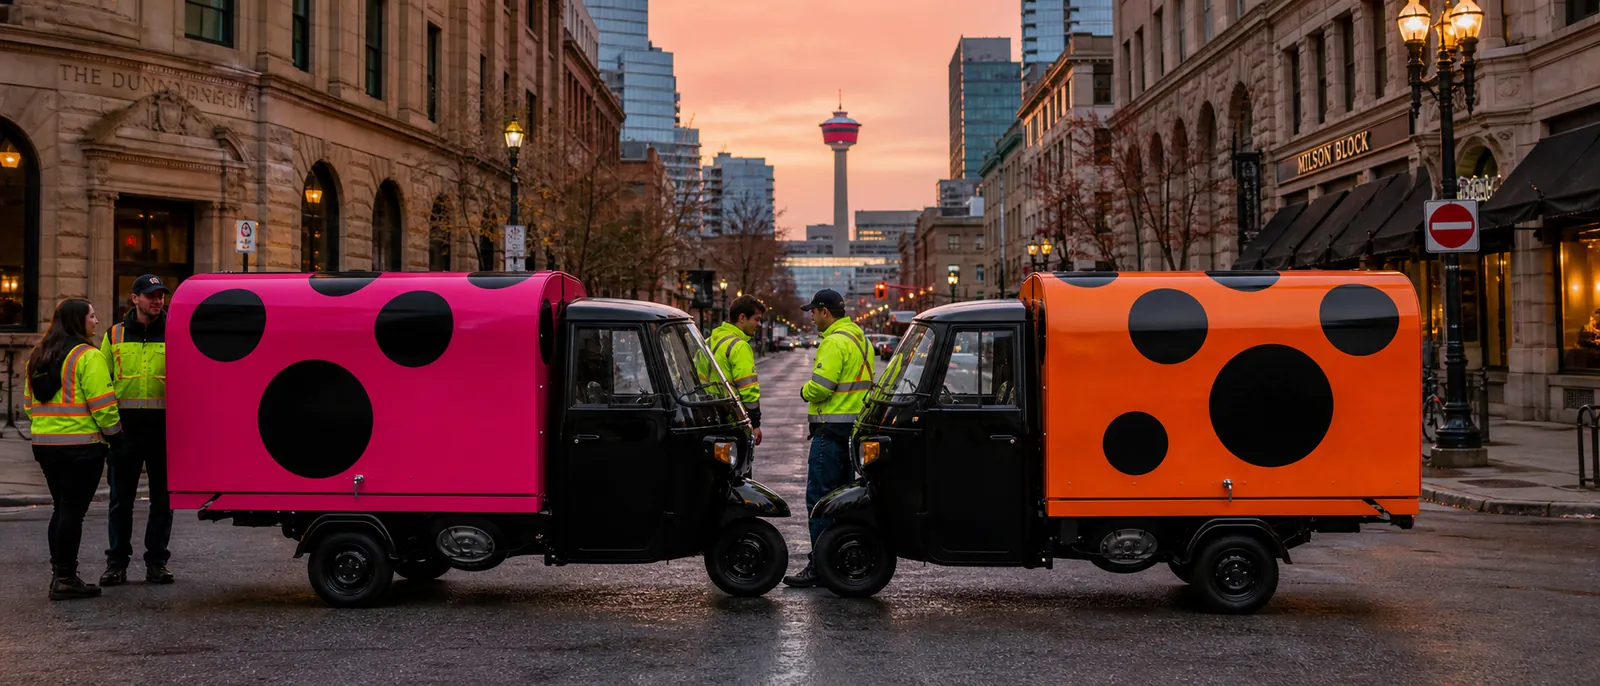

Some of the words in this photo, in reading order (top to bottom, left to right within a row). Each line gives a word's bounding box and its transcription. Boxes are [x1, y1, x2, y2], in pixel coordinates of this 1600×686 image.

[60, 64, 102, 85] THE
[1298, 145, 1332, 174] MILSON
[1335, 131, 1369, 161] BLOCK
